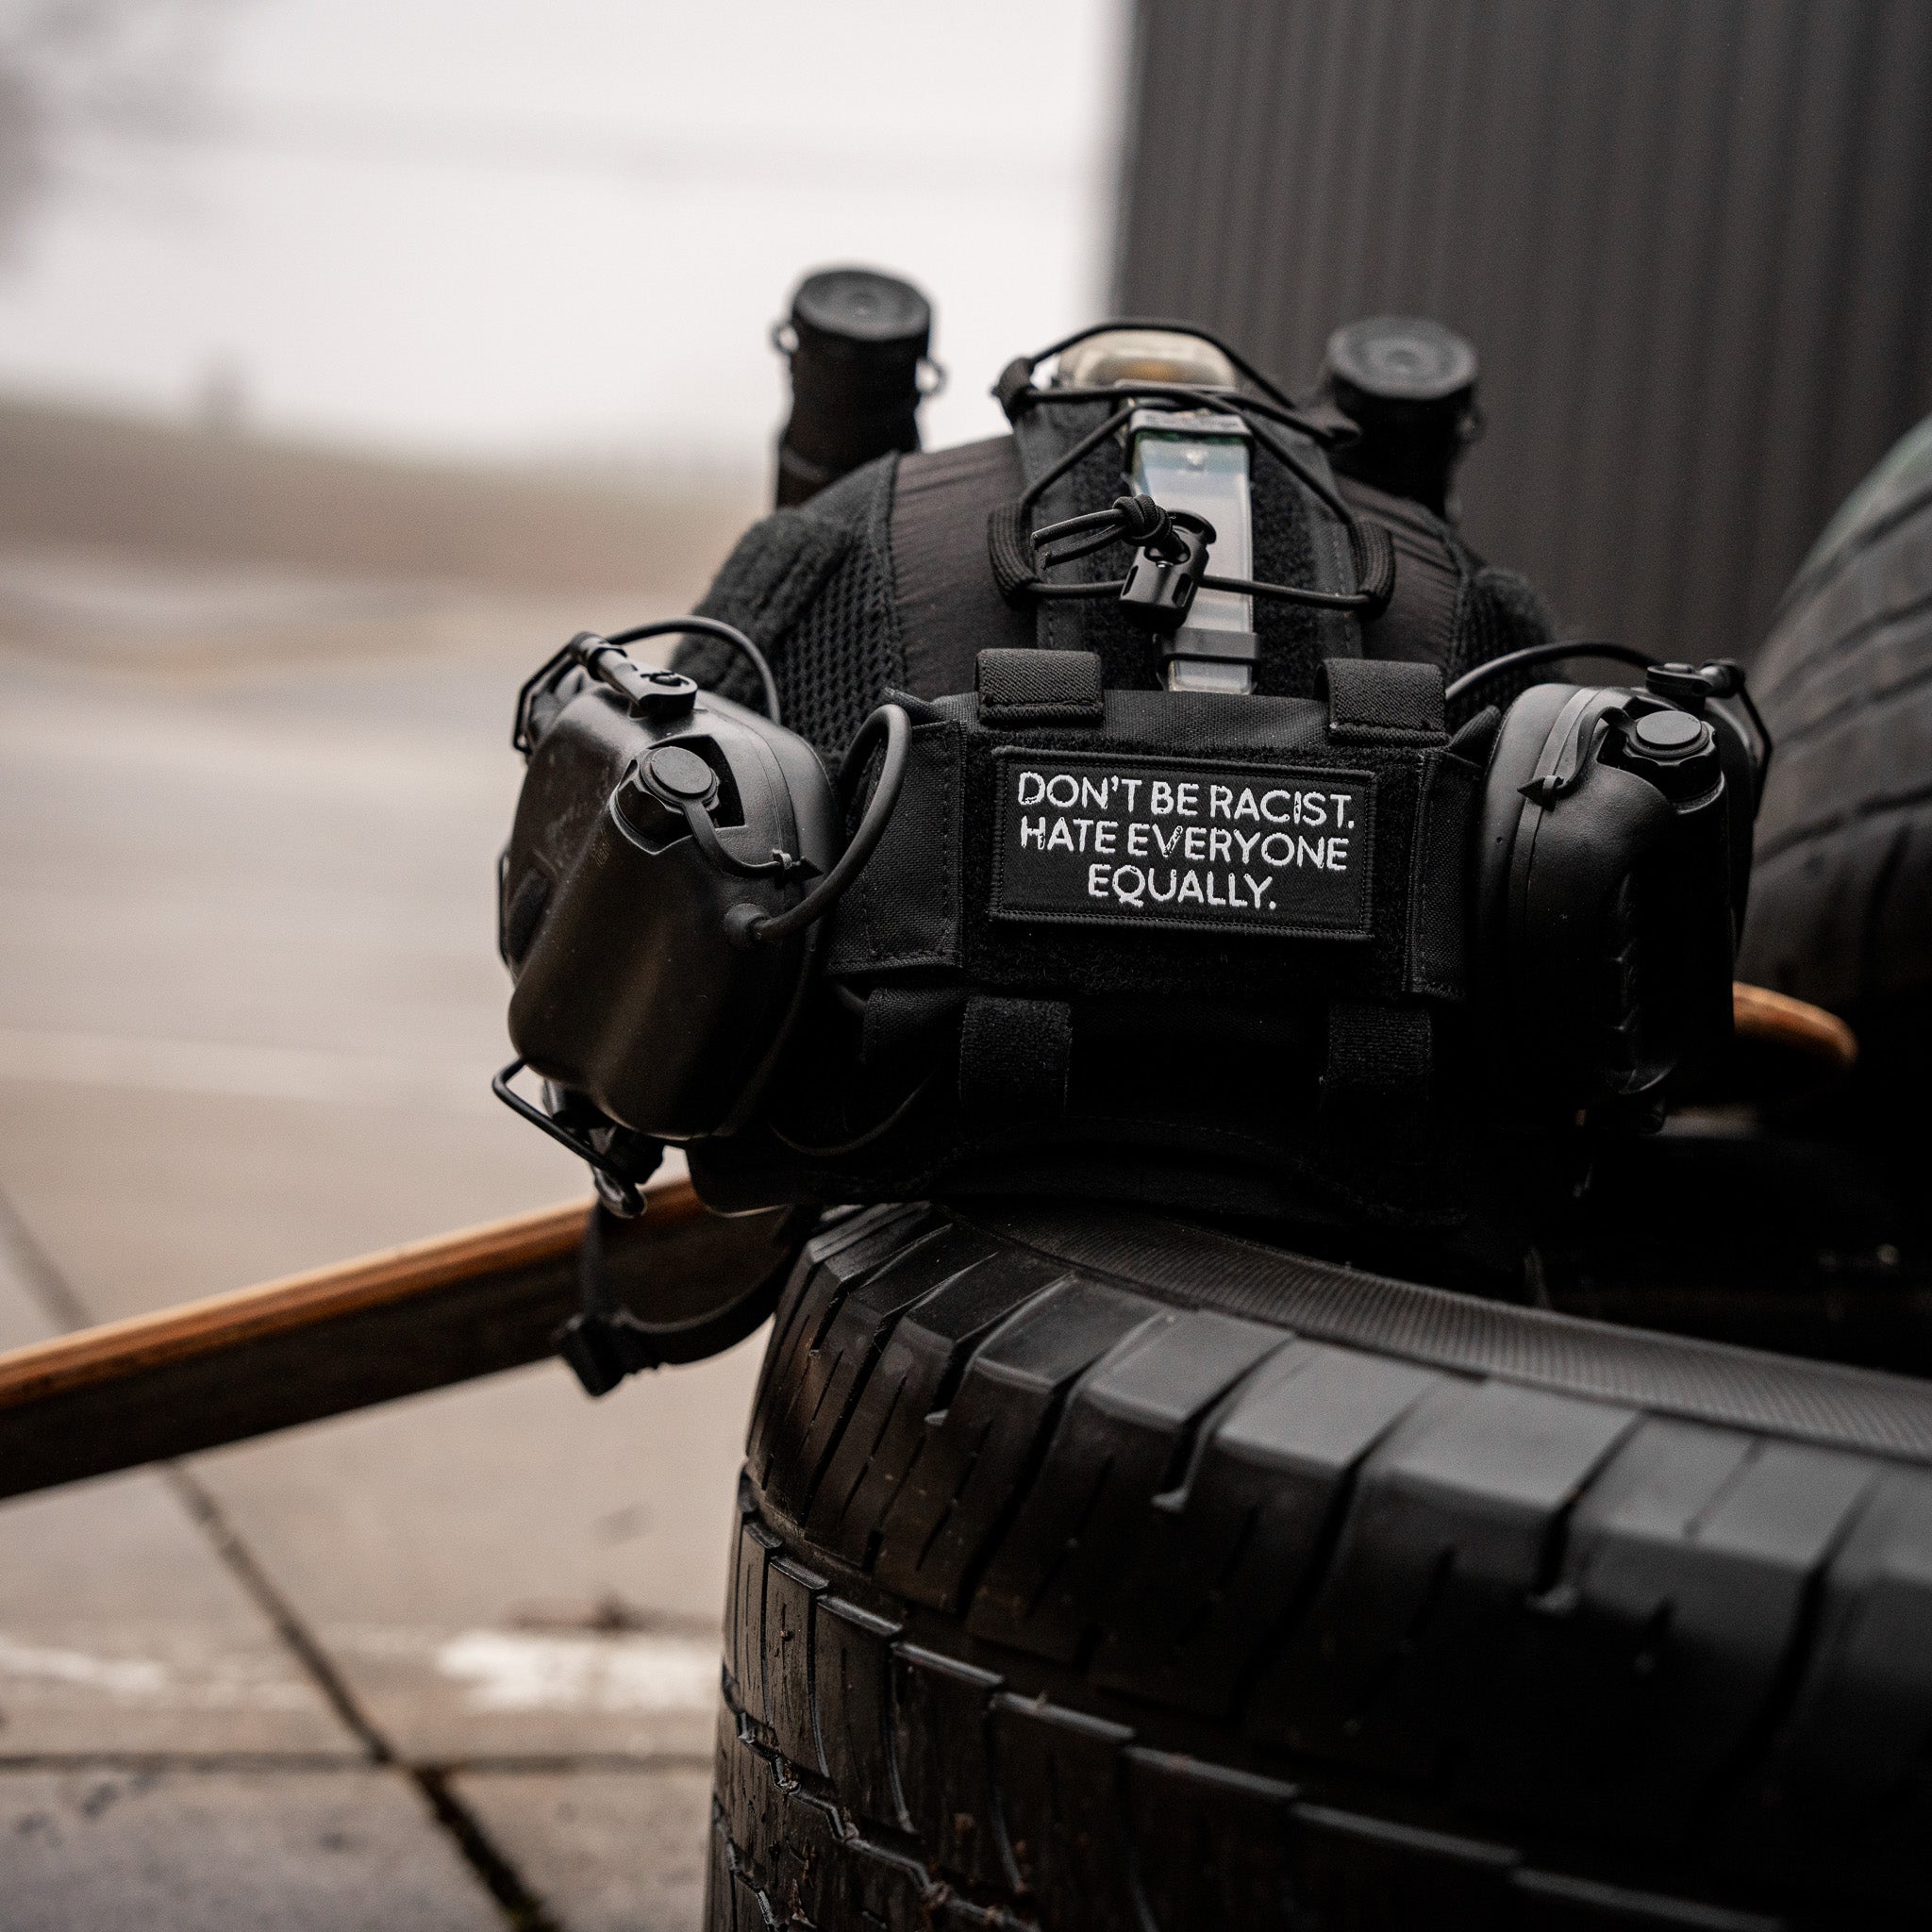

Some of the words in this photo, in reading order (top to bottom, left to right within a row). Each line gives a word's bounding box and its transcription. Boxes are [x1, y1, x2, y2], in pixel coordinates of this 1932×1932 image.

[1017, 771, 1143, 813] DON'T
[1150, 780, 1200, 817] BE
[1209, 784, 1355, 829] RACIST.
[1020, 815, 1120, 855] HATE
[1126, 823, 1350, 872] EVERYONE
[1088, 863, 1276, 910] EQUALLY.
